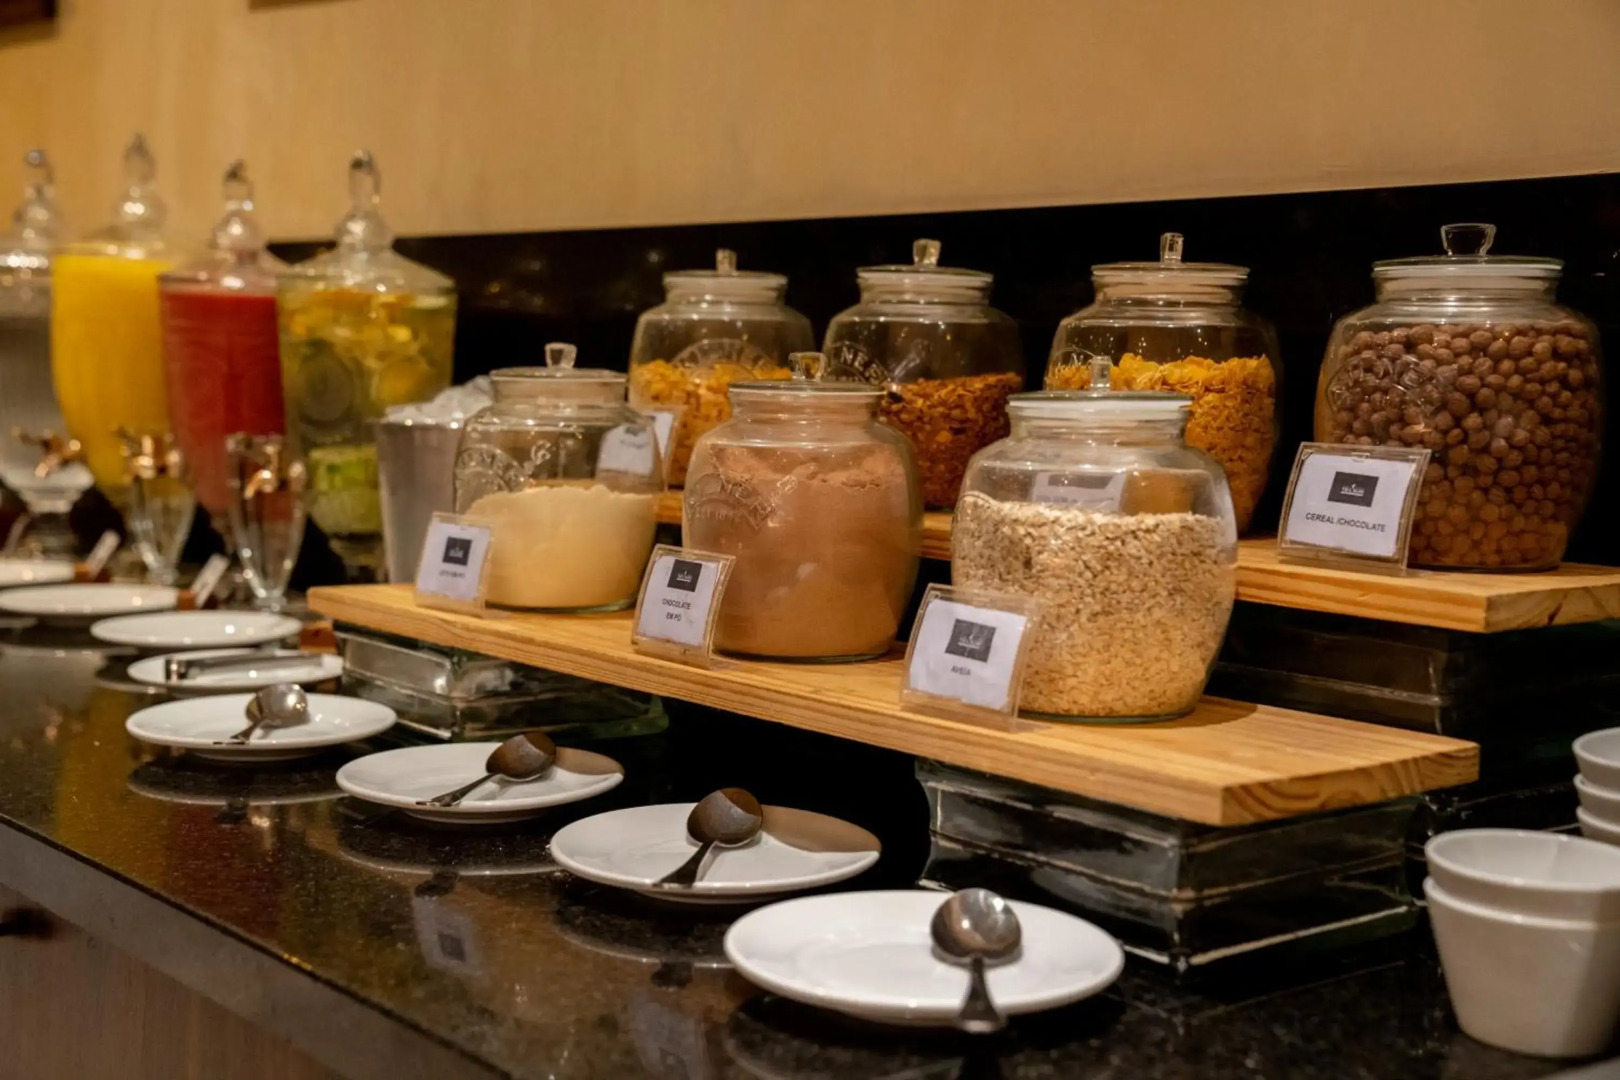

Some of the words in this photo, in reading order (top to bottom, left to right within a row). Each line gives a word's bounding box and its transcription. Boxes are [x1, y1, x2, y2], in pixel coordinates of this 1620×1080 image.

[1305, 512, 1334, 524] CEREAL
[662, 598, 691, 610] CHOCOLATE
[951, 665, 971, 676] AVEIA
